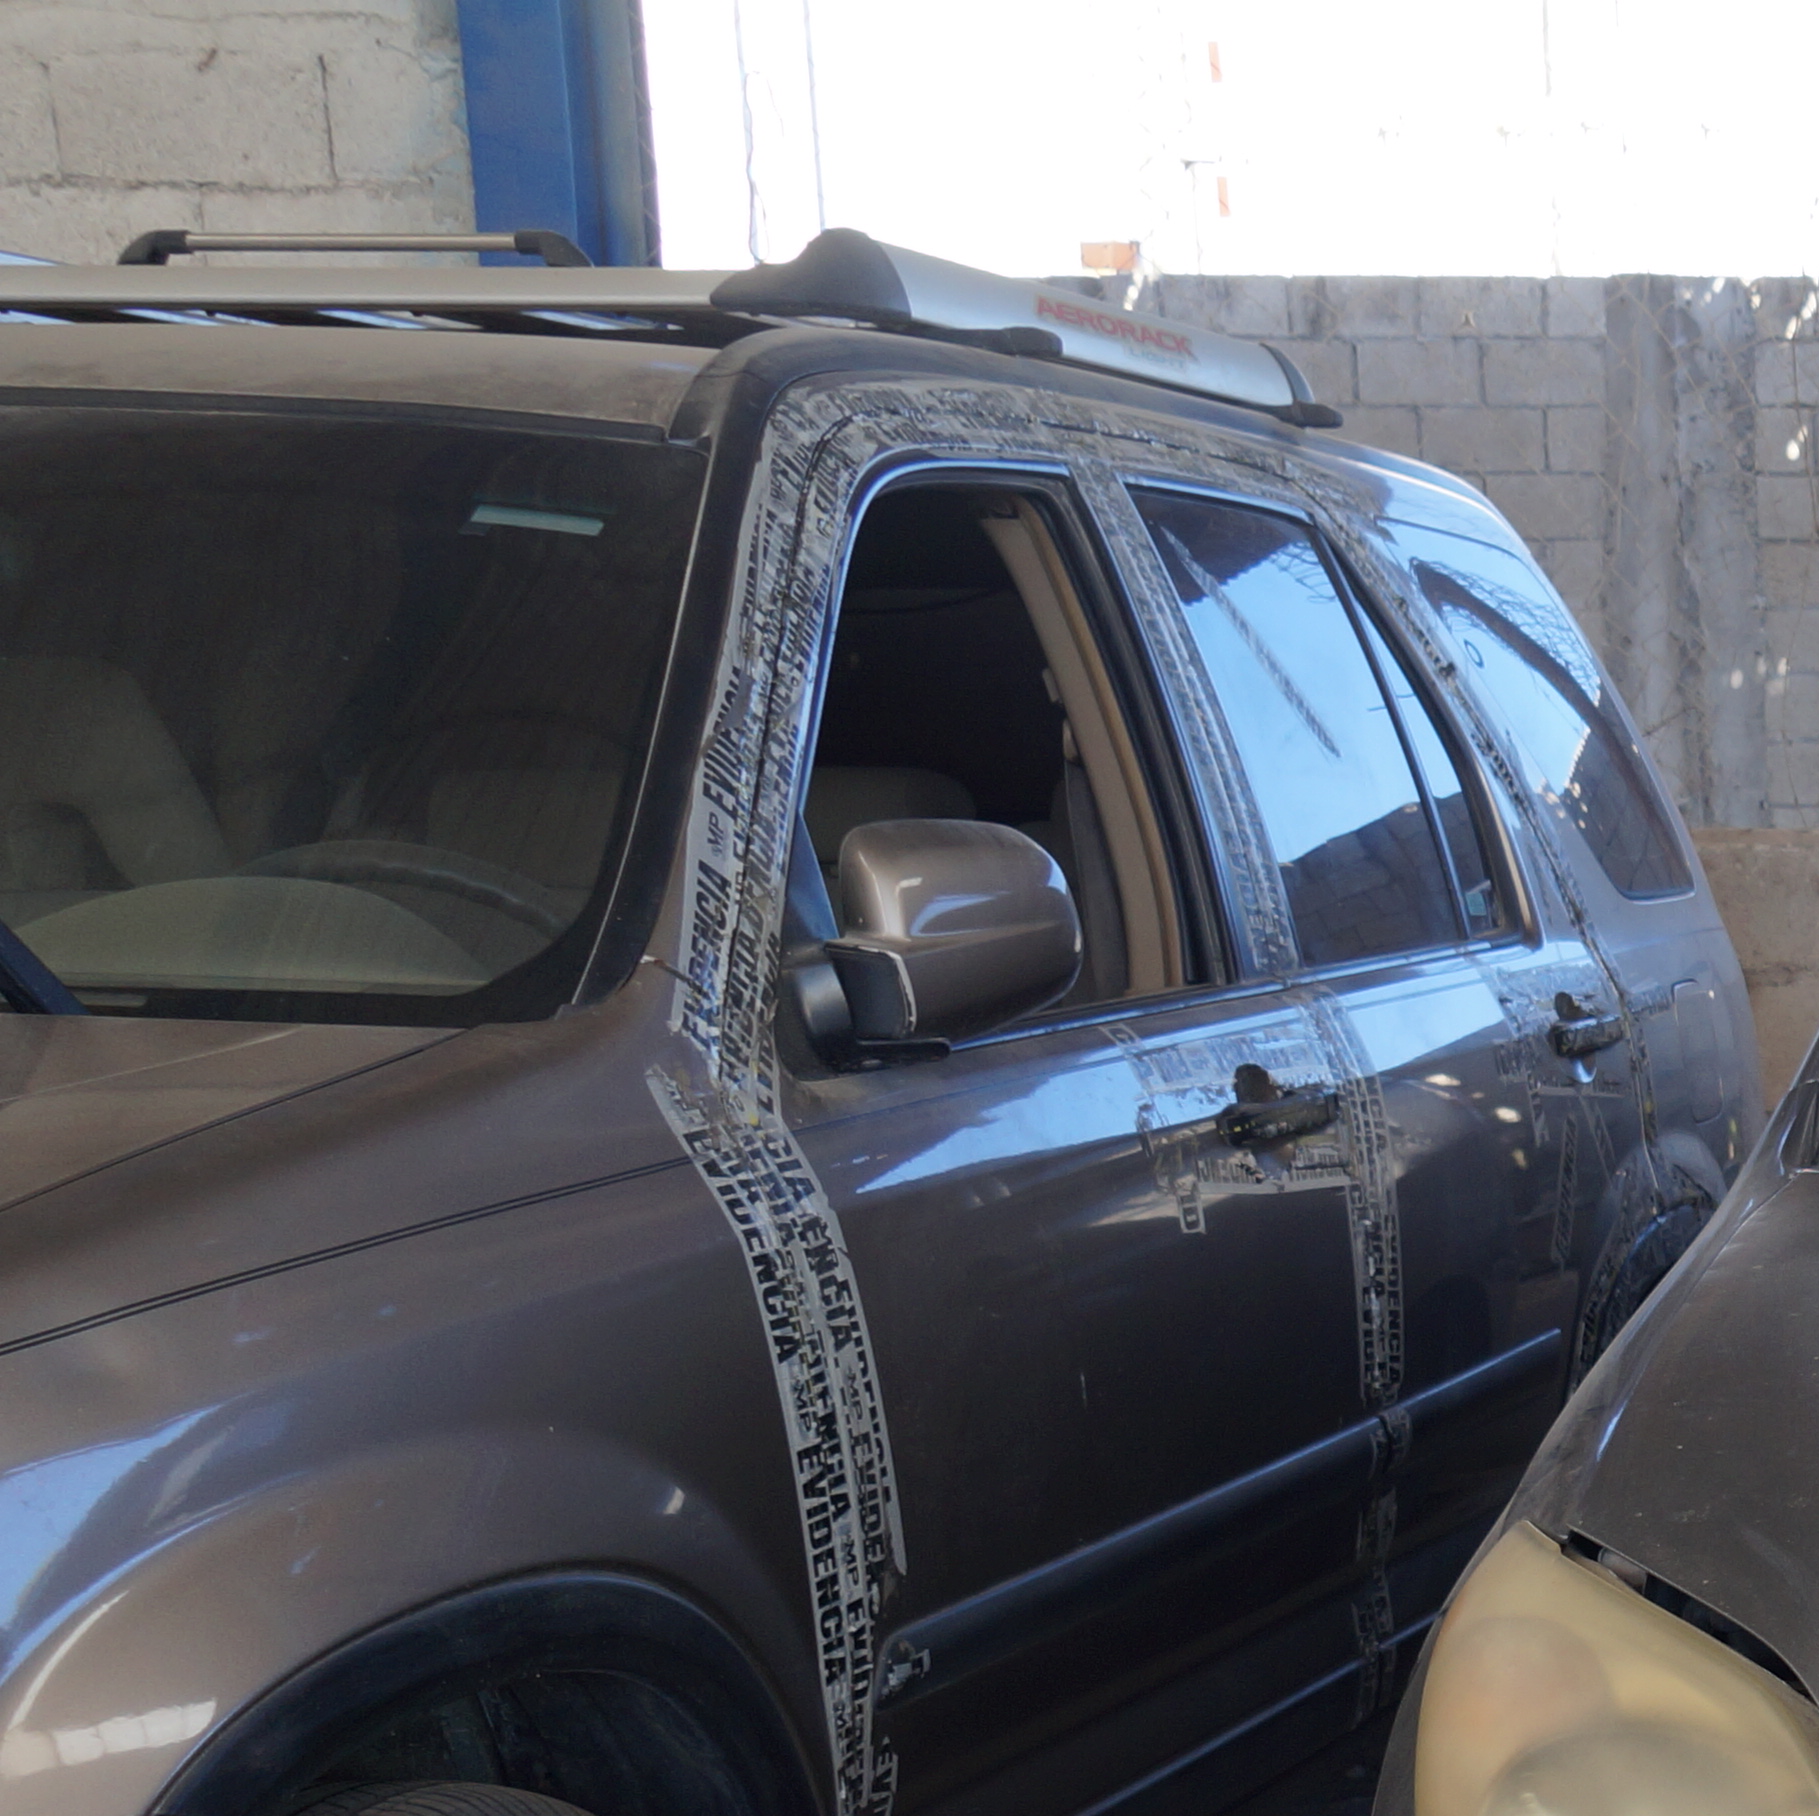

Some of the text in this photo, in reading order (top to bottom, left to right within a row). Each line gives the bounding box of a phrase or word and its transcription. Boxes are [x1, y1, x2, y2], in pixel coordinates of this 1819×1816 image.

[1036, 295, 1196, 361] AERORACK
[683, 1128, 800, 1364] EVIDENCIA
[797, 1440, 848, 1688] EVIDENCIA
